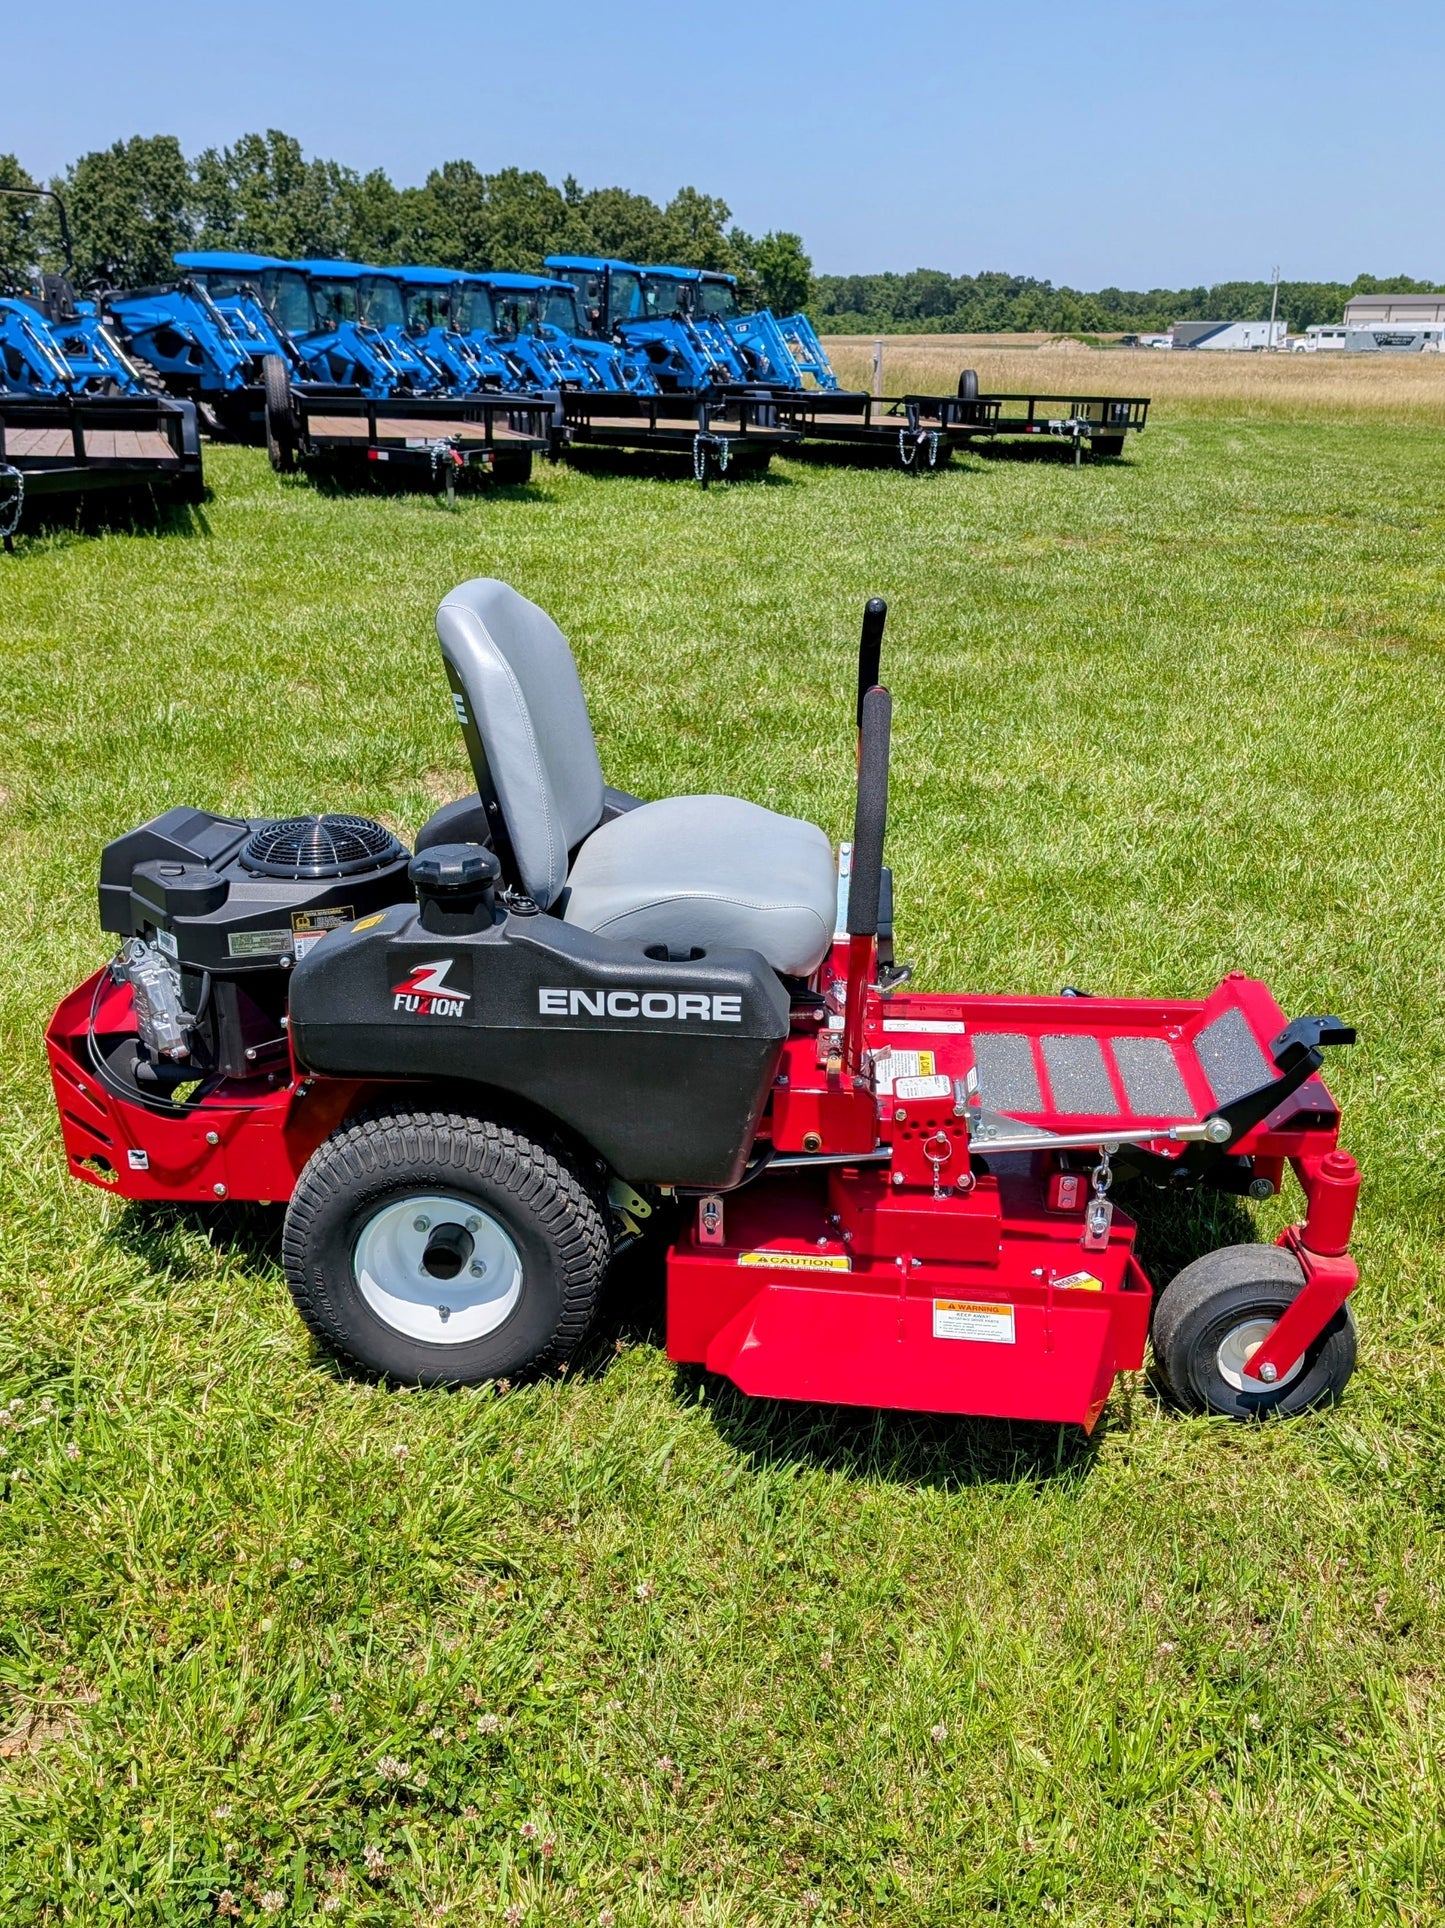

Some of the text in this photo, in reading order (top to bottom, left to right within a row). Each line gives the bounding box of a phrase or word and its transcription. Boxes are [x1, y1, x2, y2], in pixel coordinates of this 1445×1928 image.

[393, 993, 465, 1017] FUZION
[539, 989, 742, 1022] ENCORE
[770, 1256, 834, 1267] CAUTION
[957, 1304, 1000, 1313] WARNING
